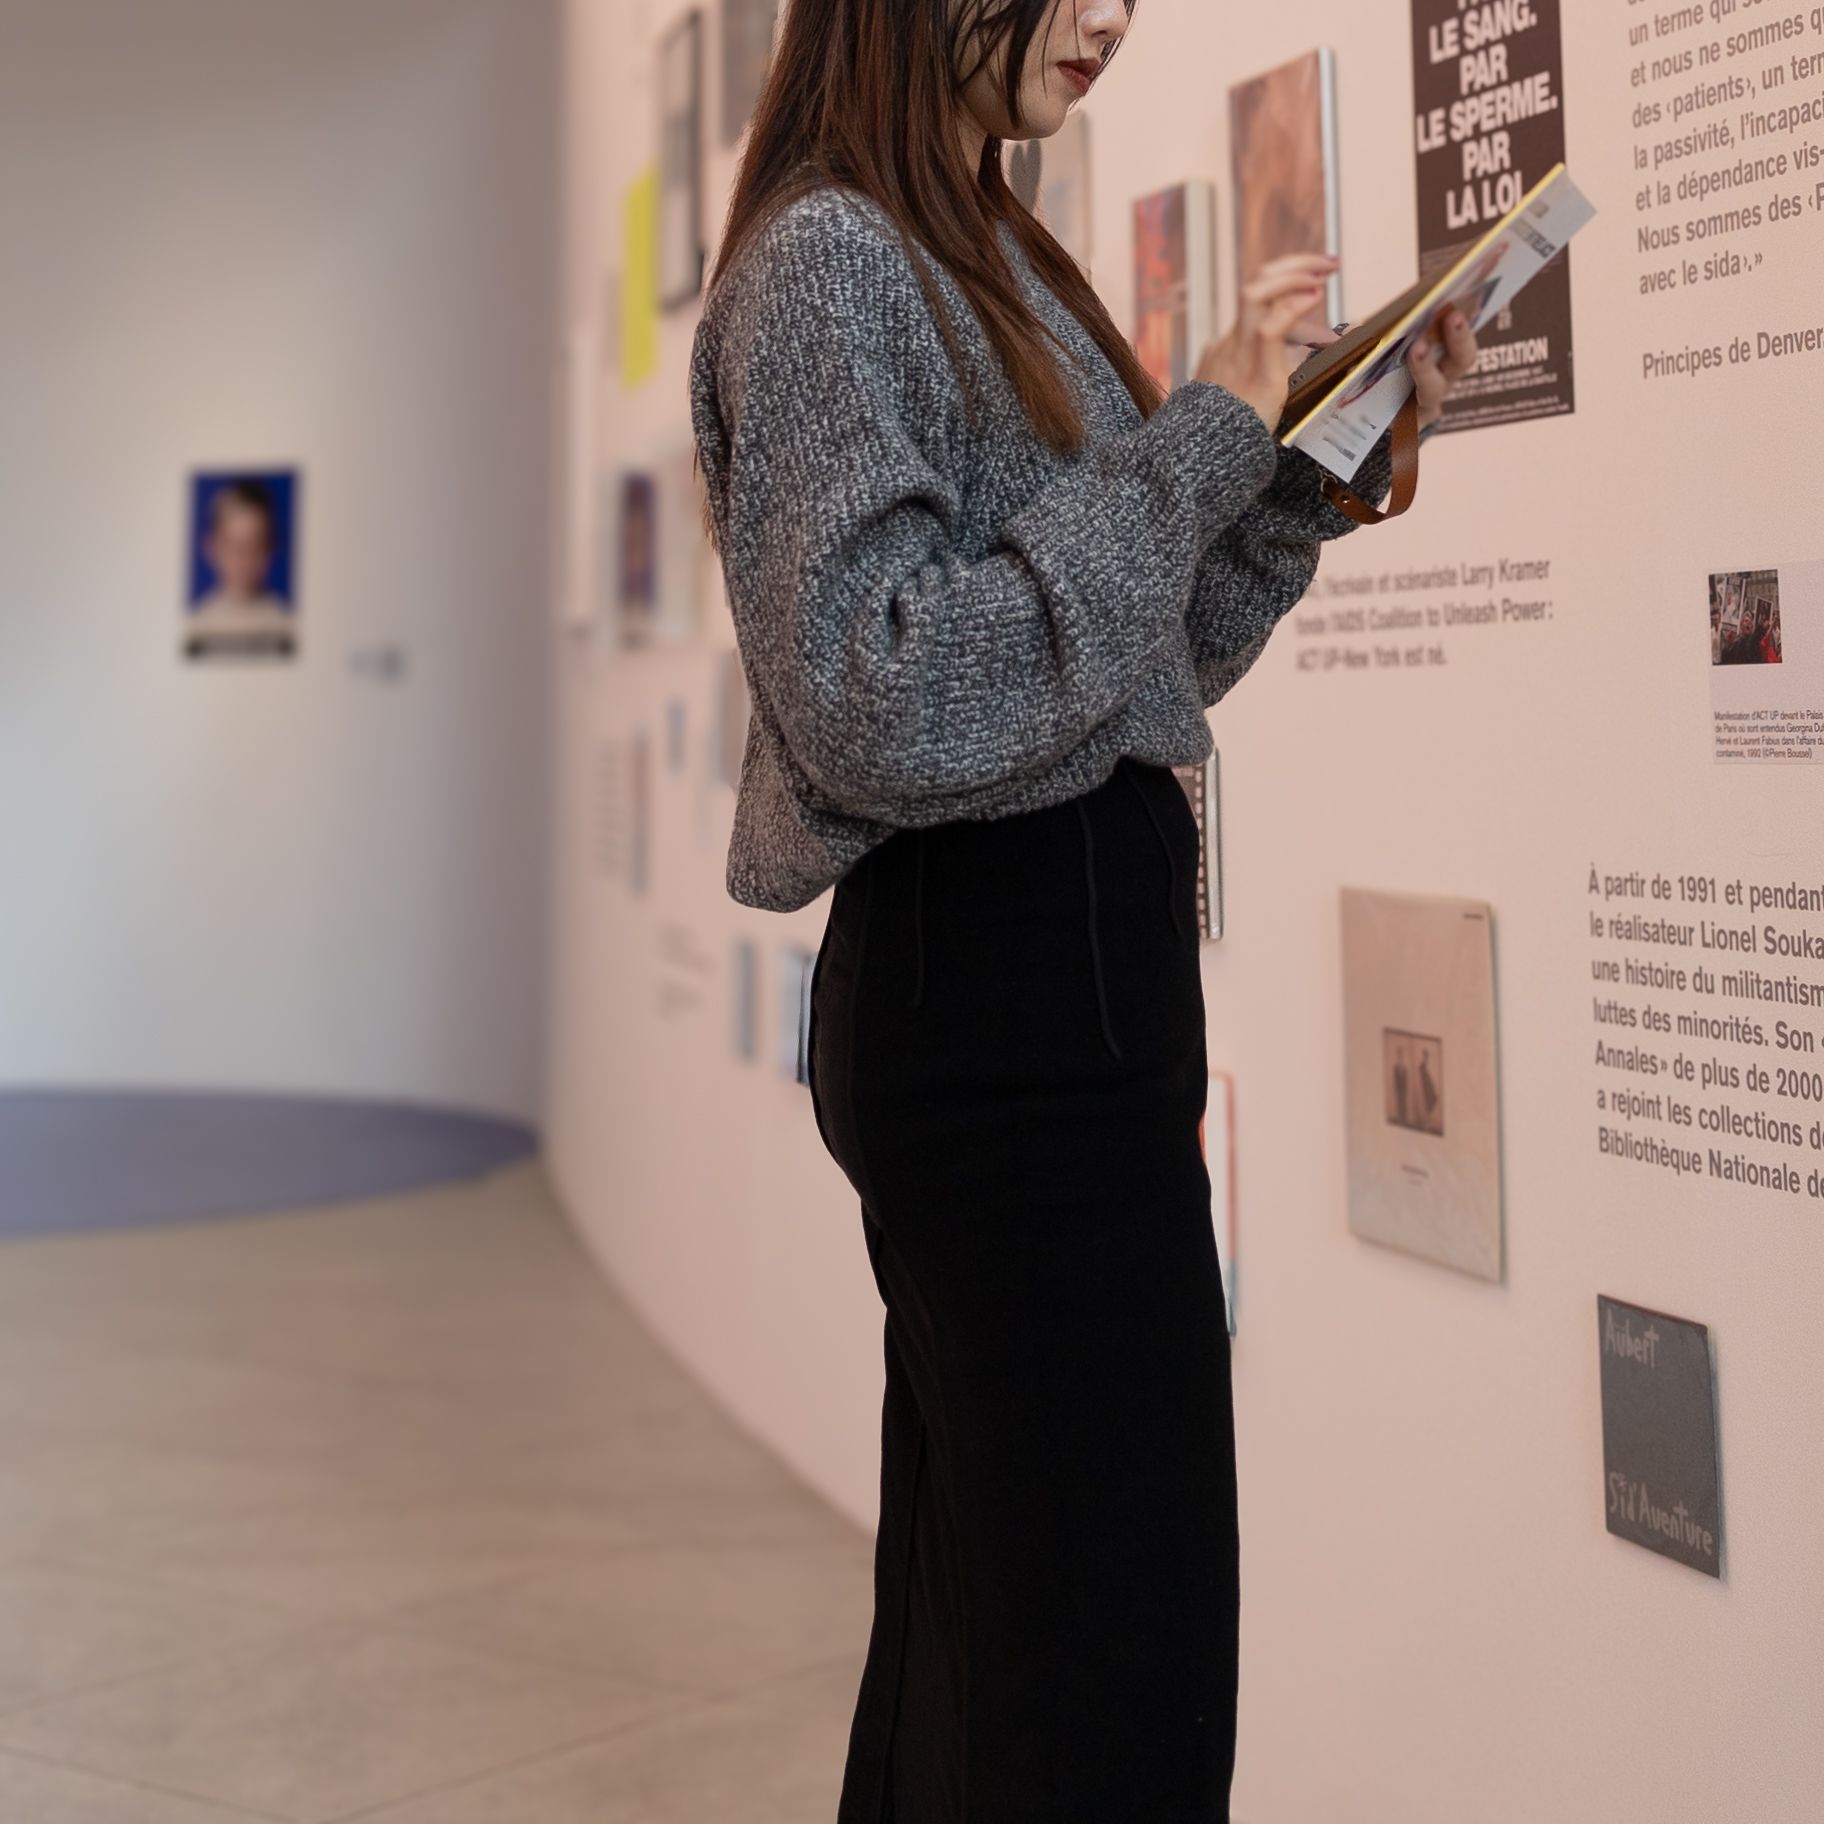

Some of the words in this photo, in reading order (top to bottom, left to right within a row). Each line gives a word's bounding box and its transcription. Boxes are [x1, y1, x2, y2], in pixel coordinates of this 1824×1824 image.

[1428, 16, 1461, 65] LE
[1630, 60, 1647, 89] et
[1651, 50, 1694, 81] nous
[1698, 41, 1721, 67] ne
[1726, 13, 1805, 58] sommes
[1459, 42, 1508, 96] PAR
[1416, 106, 1447, 154] LE
[1449, 70, 1559, 143] SPERME.
[1462, 130, 1512, 182] PAR
[1633, 144, 1649, 171] la
[1653, 118, 1735, 171] passivité,
[1446, 184, 1479, 230] LA
[1637, 224, 1681, 254] Nous
[1685, 204, 1763, 242] sommes
[1767, 193, 1803, 223] des
[1639, 268, 1677, 296] avec
[1681, 259, 1699, 286] le
[1472, 335, 1550, 374] FESTATION
[1642, 345, 1723, 380] Principes
[1728, 336, 1751, 365] de
[1461, 562, 1495, 589] Larry
[1498, 558, 1551, 583] Kramer
[1444, 600, 1498, 626] Unleash
[1501, 597, 1554, 622] Power:
[1588, 861, 1600, 896] À
[1604, 871, 1647, 901] partir
[1650, 872, 1672, 901] de
[1677, 875, 1717, 904] 1991
[1724, 879, 1744, 906] et
[1589, 910, 1604, 939] le
[1608, 913, 1695, 947] réalisateur
[1700, 920, 1757, 953] Lionel
[1592, 996, 1638, 1028] luttes
[1641, 1004, 1672, 1034] des
[1676, 1010, 1769, 1047] minorités.
[1775, 1020, 1815, 1054] Son
[1598, 1125, 1703, 1177] Bibliothèque
[1708, 1148, 1801, 1195] Nationale
[1605, 1307, 1659, 1370] Aubert
